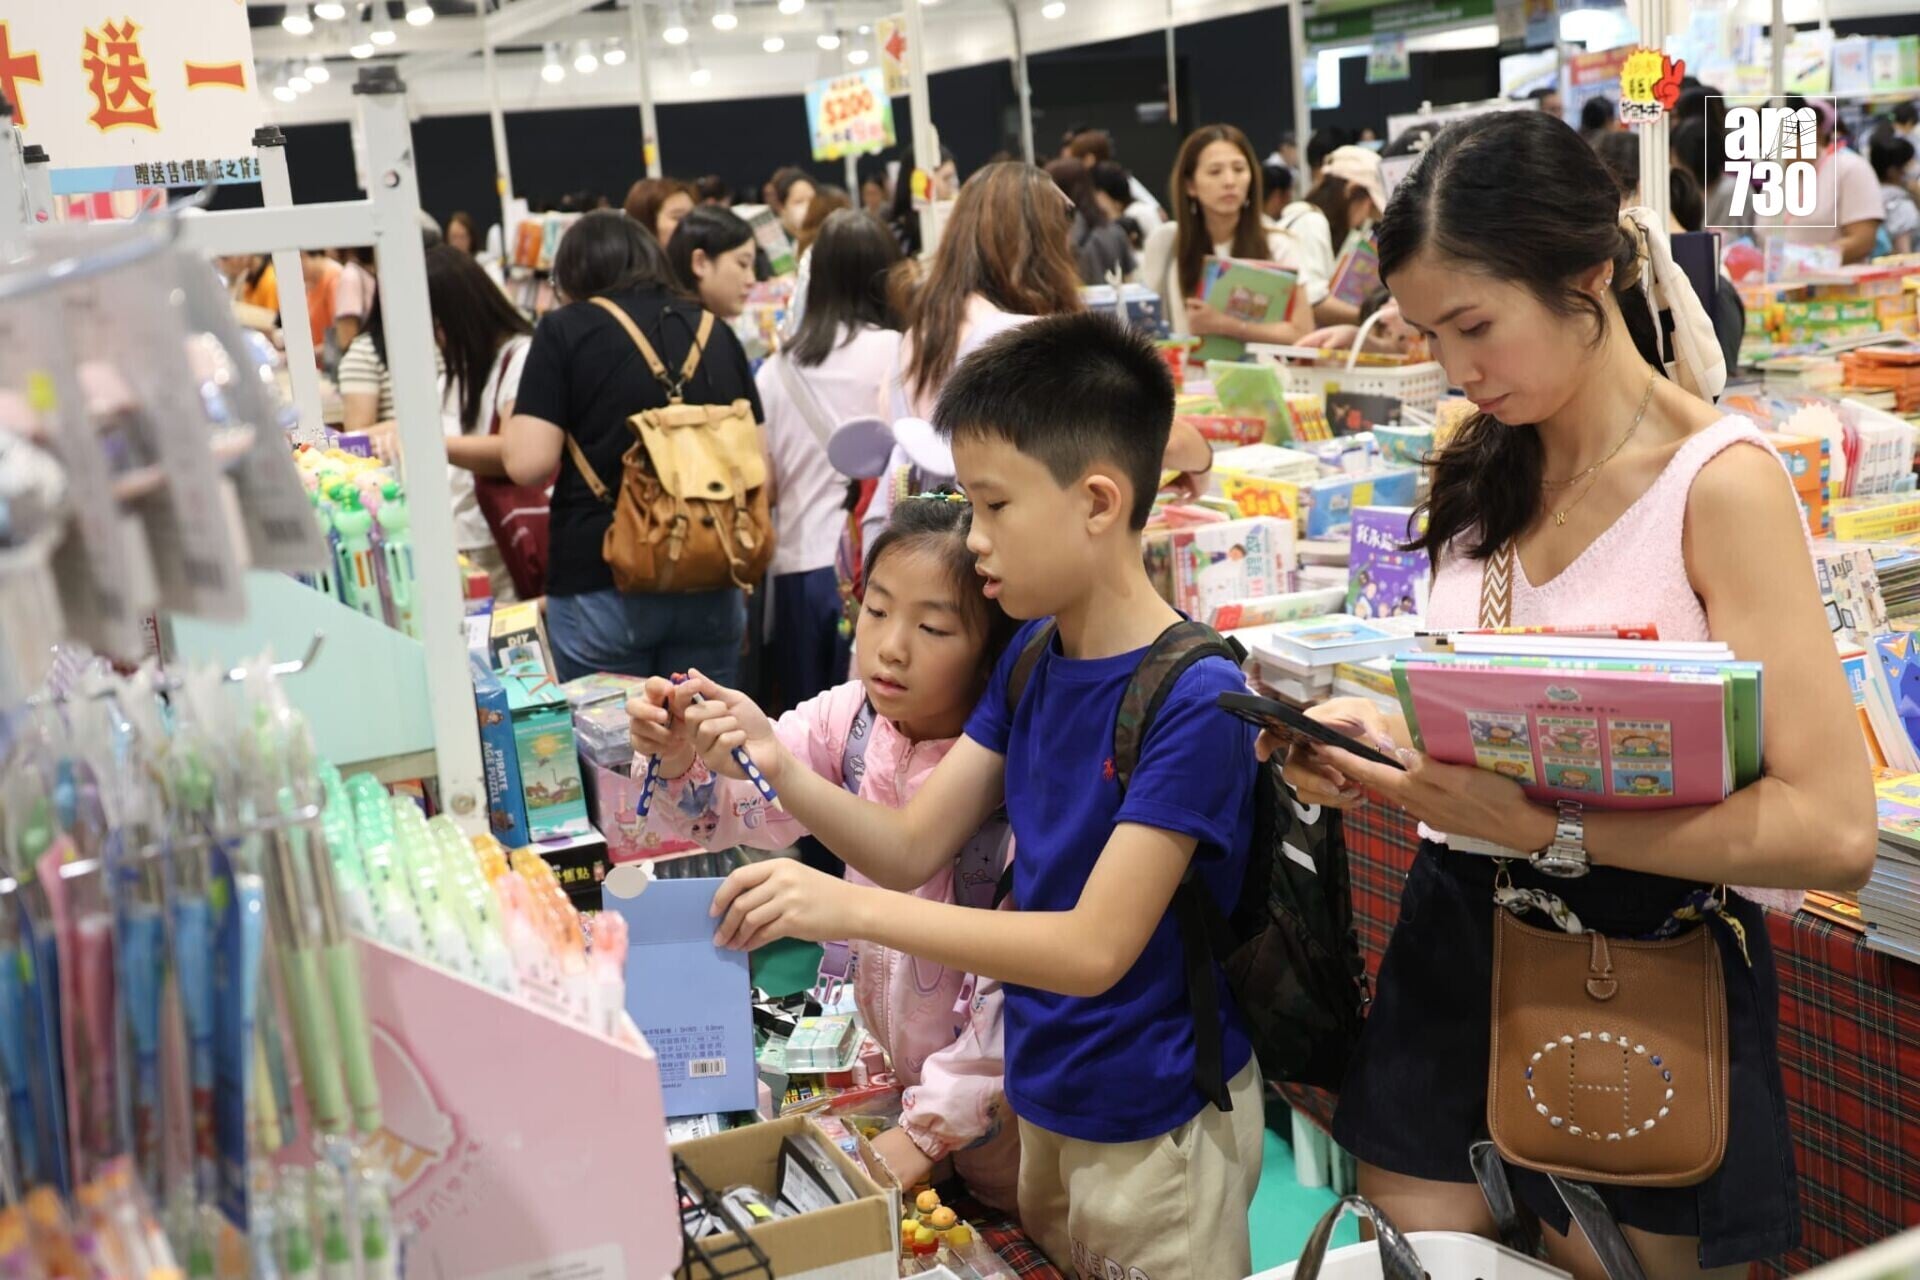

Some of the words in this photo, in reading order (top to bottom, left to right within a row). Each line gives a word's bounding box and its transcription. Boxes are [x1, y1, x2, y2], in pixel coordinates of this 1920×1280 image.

[507, 633, 530, 648] DIY
[483, 742, 494, 766] AGE
[488, 767, 501, 803] PUZZLE
[494, 750, 508, 791] PIRATE
